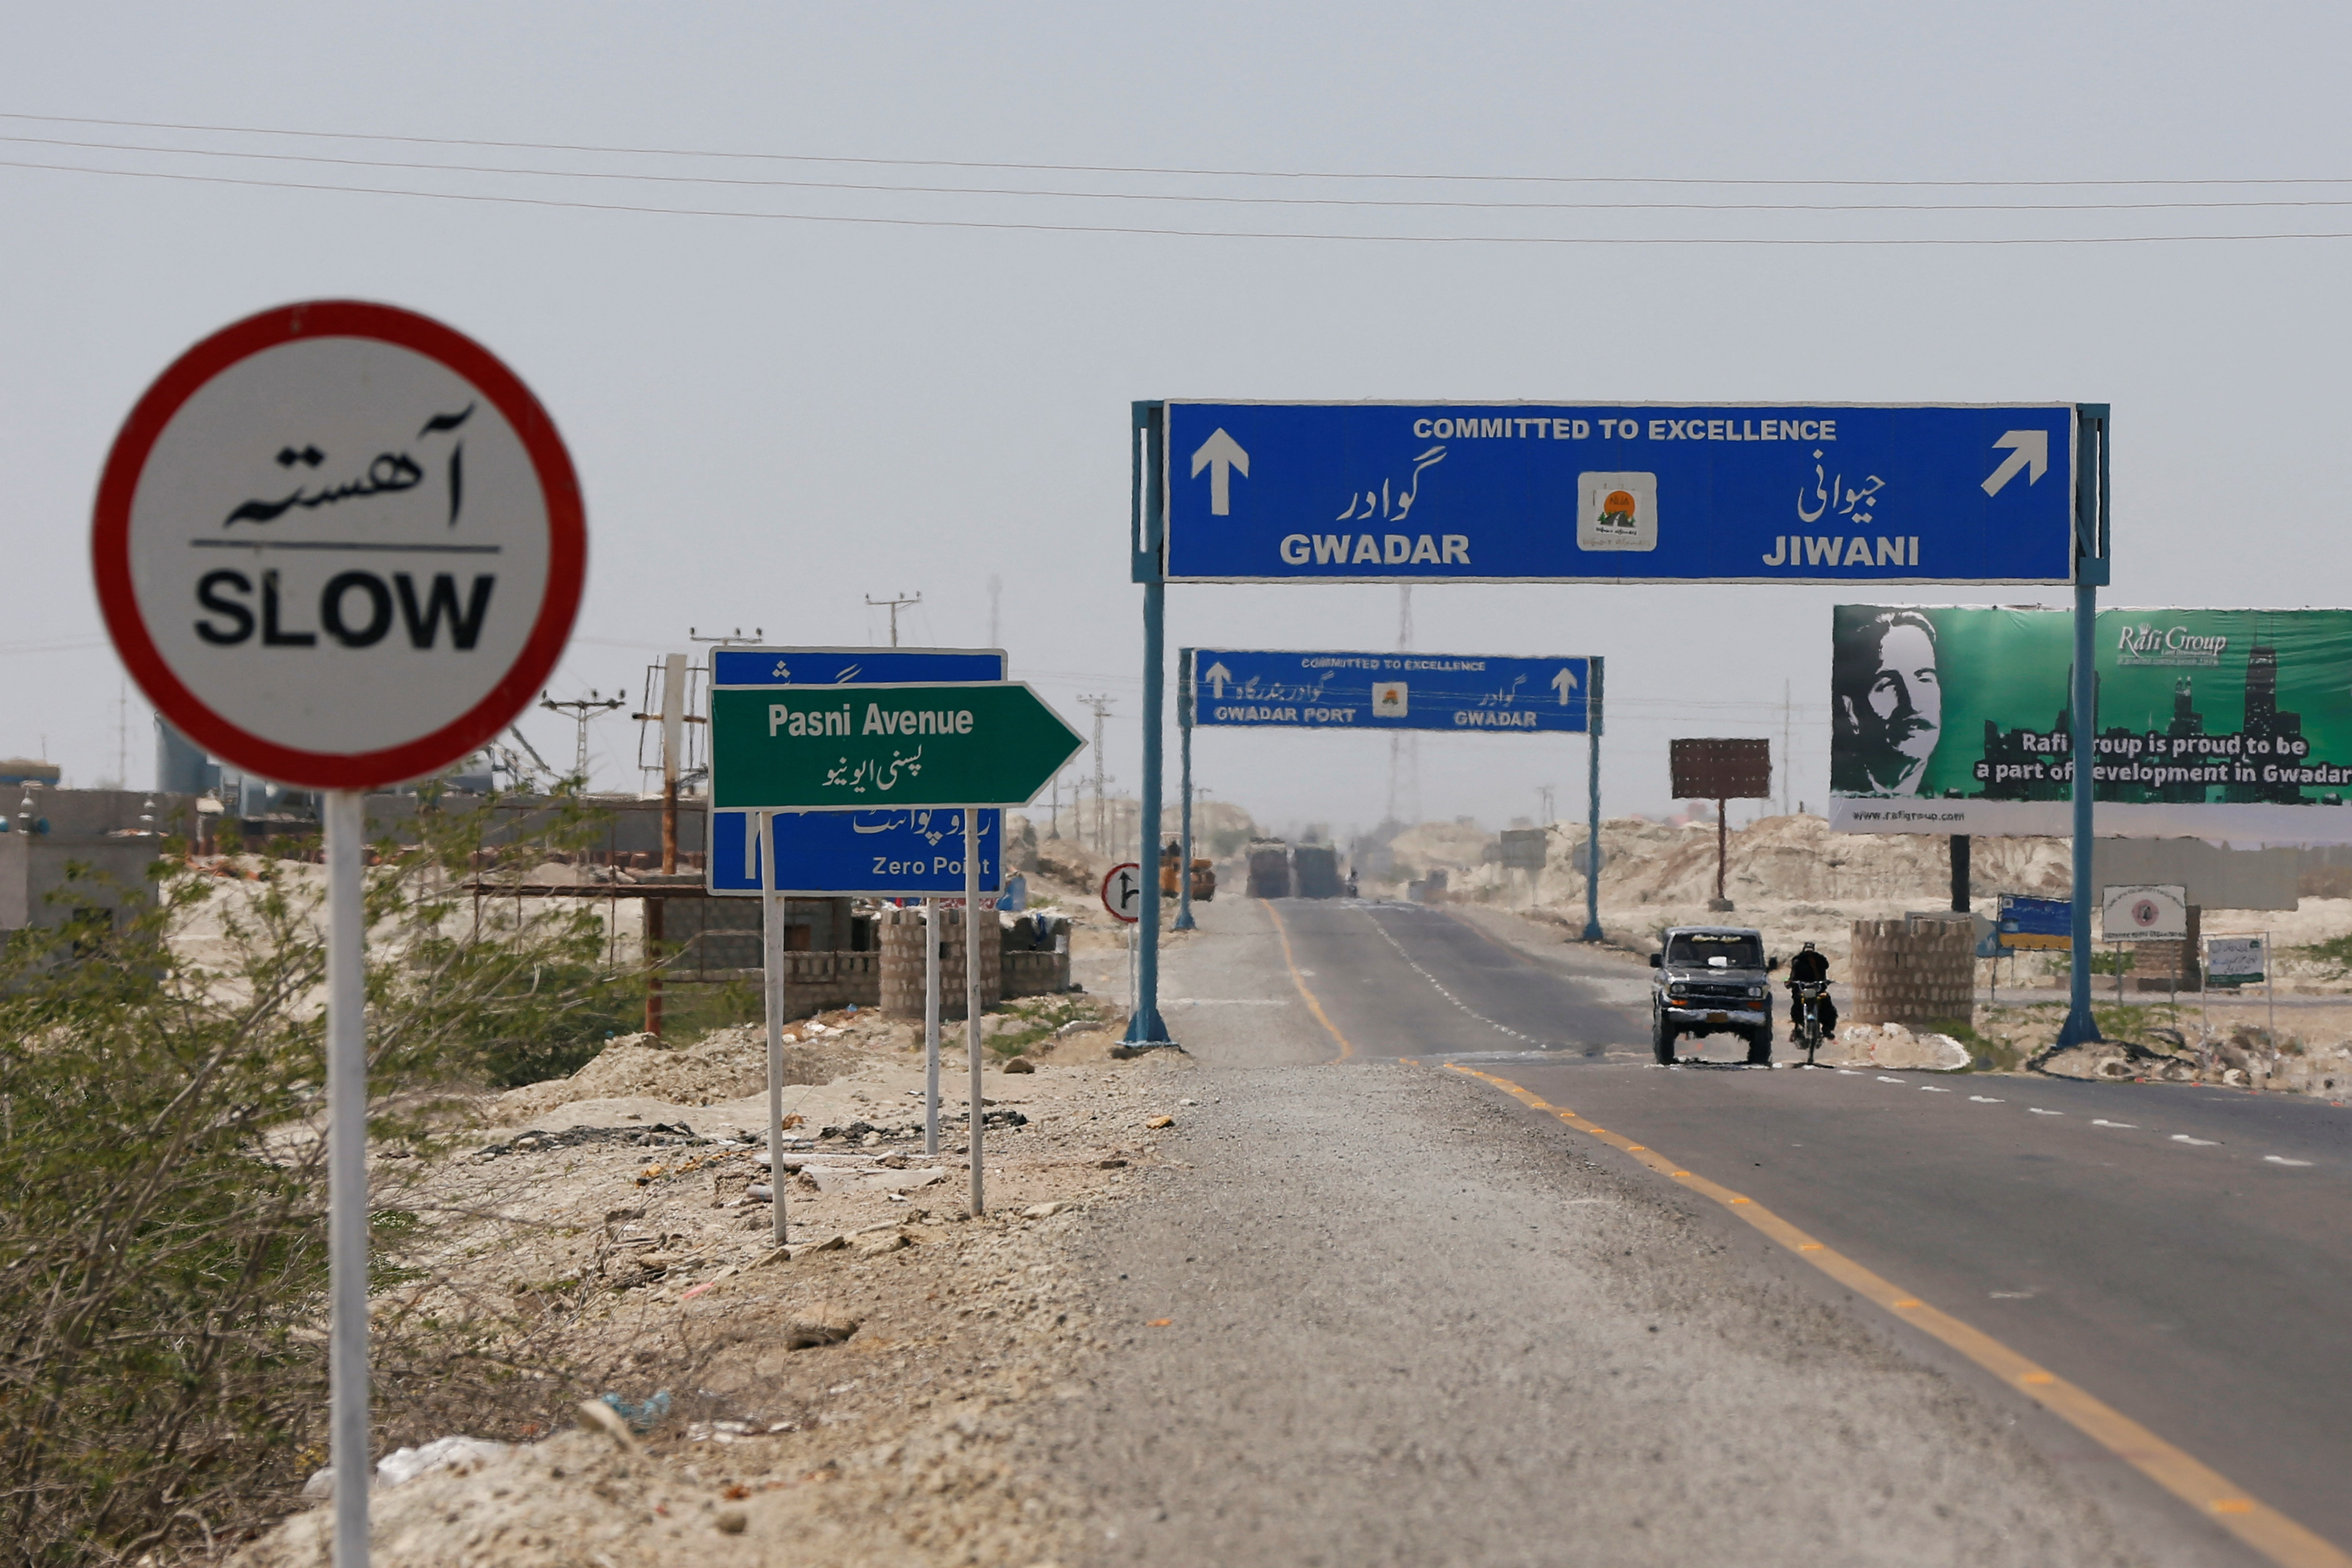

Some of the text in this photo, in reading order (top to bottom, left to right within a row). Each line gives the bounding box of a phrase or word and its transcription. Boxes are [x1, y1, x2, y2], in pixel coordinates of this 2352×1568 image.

[1413, 418, 1837, 441] COMMITTED TO EXCELLENCE
[1336, 445, 1448, 521] گوادر
[1279, 533, 1471, 565] GWADAR
[1762, 536, 1919, 567] JIWANI
[195, 570, 496, 651] SLOW
[2118, 626, 2227, 659] Rafi Group
[1301, 658, 1486, 671] COMMITTED TO EXCELLENCE
[1477, 673, 1528, 707] گوادر
[768, 703, 974, 737] Pasni Avenue
[1214, 706, 1356, 723] GWADAR PORT
[1454, 710, 1537, 727] GWADAR
[2022, 733, 2308, 759] Rafi roup is proud to be
[876, 744, 922, 791] پسنی
[1976, 761, 2352, 788] a part of evelopment in Gwadar
[872, 857, 990, 875] Zero Poit
